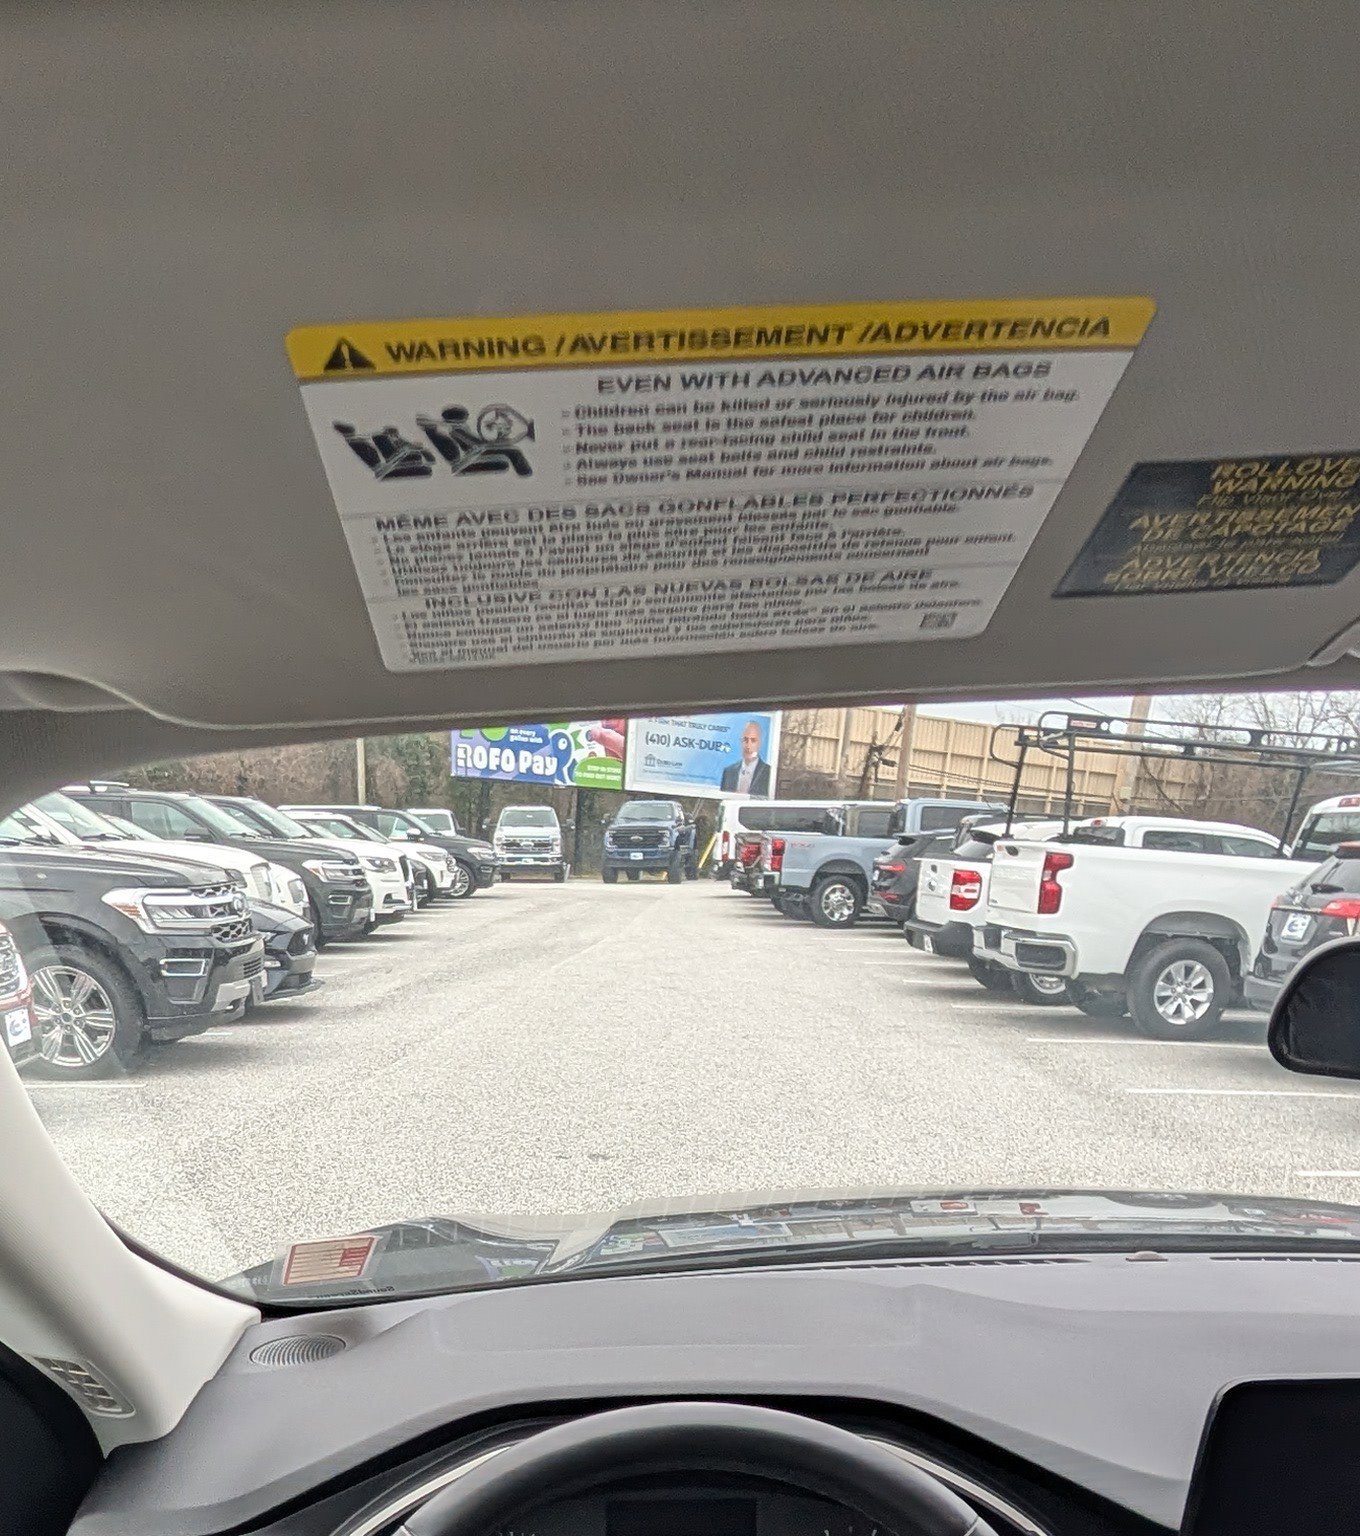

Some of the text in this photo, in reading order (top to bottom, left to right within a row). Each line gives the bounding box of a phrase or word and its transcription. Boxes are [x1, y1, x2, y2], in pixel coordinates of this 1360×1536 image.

[385, 334, 546, 363] WARNING
[597, 361, 1052, 394] EVEN WITH ADVANCED AIR BAGS
[456, 509, 520, 526] AVEC
[1190, 516, 1355, 539] CAPOTAGE
[1121, 549, 1321, 571] ADVERTENCIA
[645, 731, 671, 748] (410)
[519, 750, 558, 776] Pay
